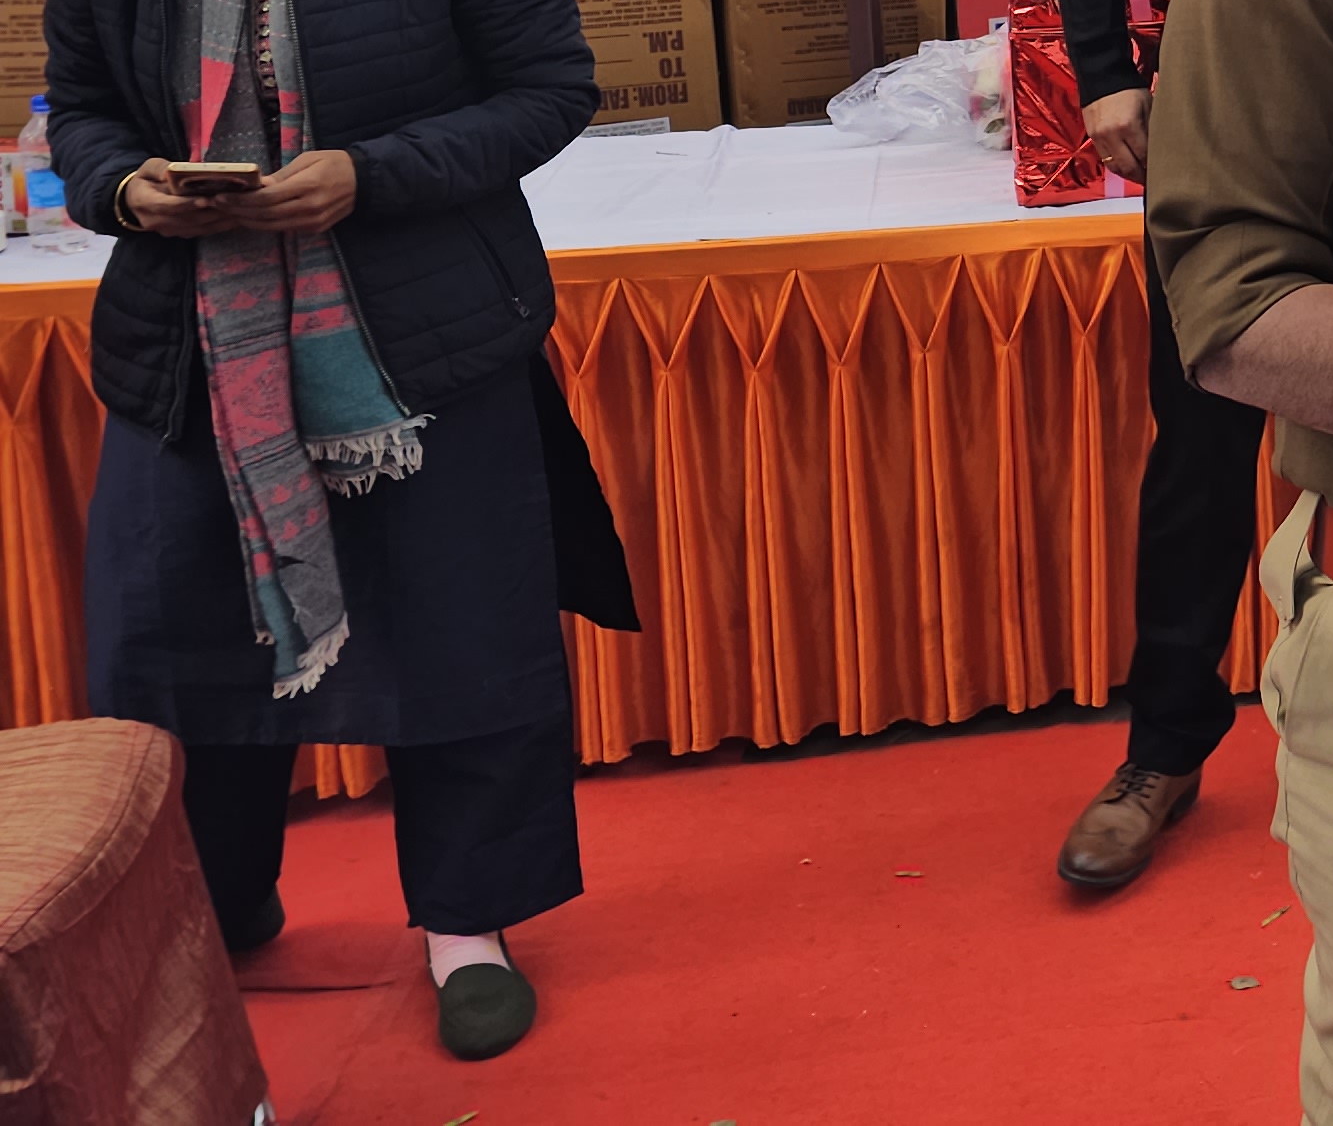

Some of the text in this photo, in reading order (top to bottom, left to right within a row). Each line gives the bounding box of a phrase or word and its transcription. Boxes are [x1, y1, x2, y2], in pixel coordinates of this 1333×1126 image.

[642, 29, 685, 54] P.M.
[659, 56, 687, 80] TO
[633, 81, 689, 108] FROM:
